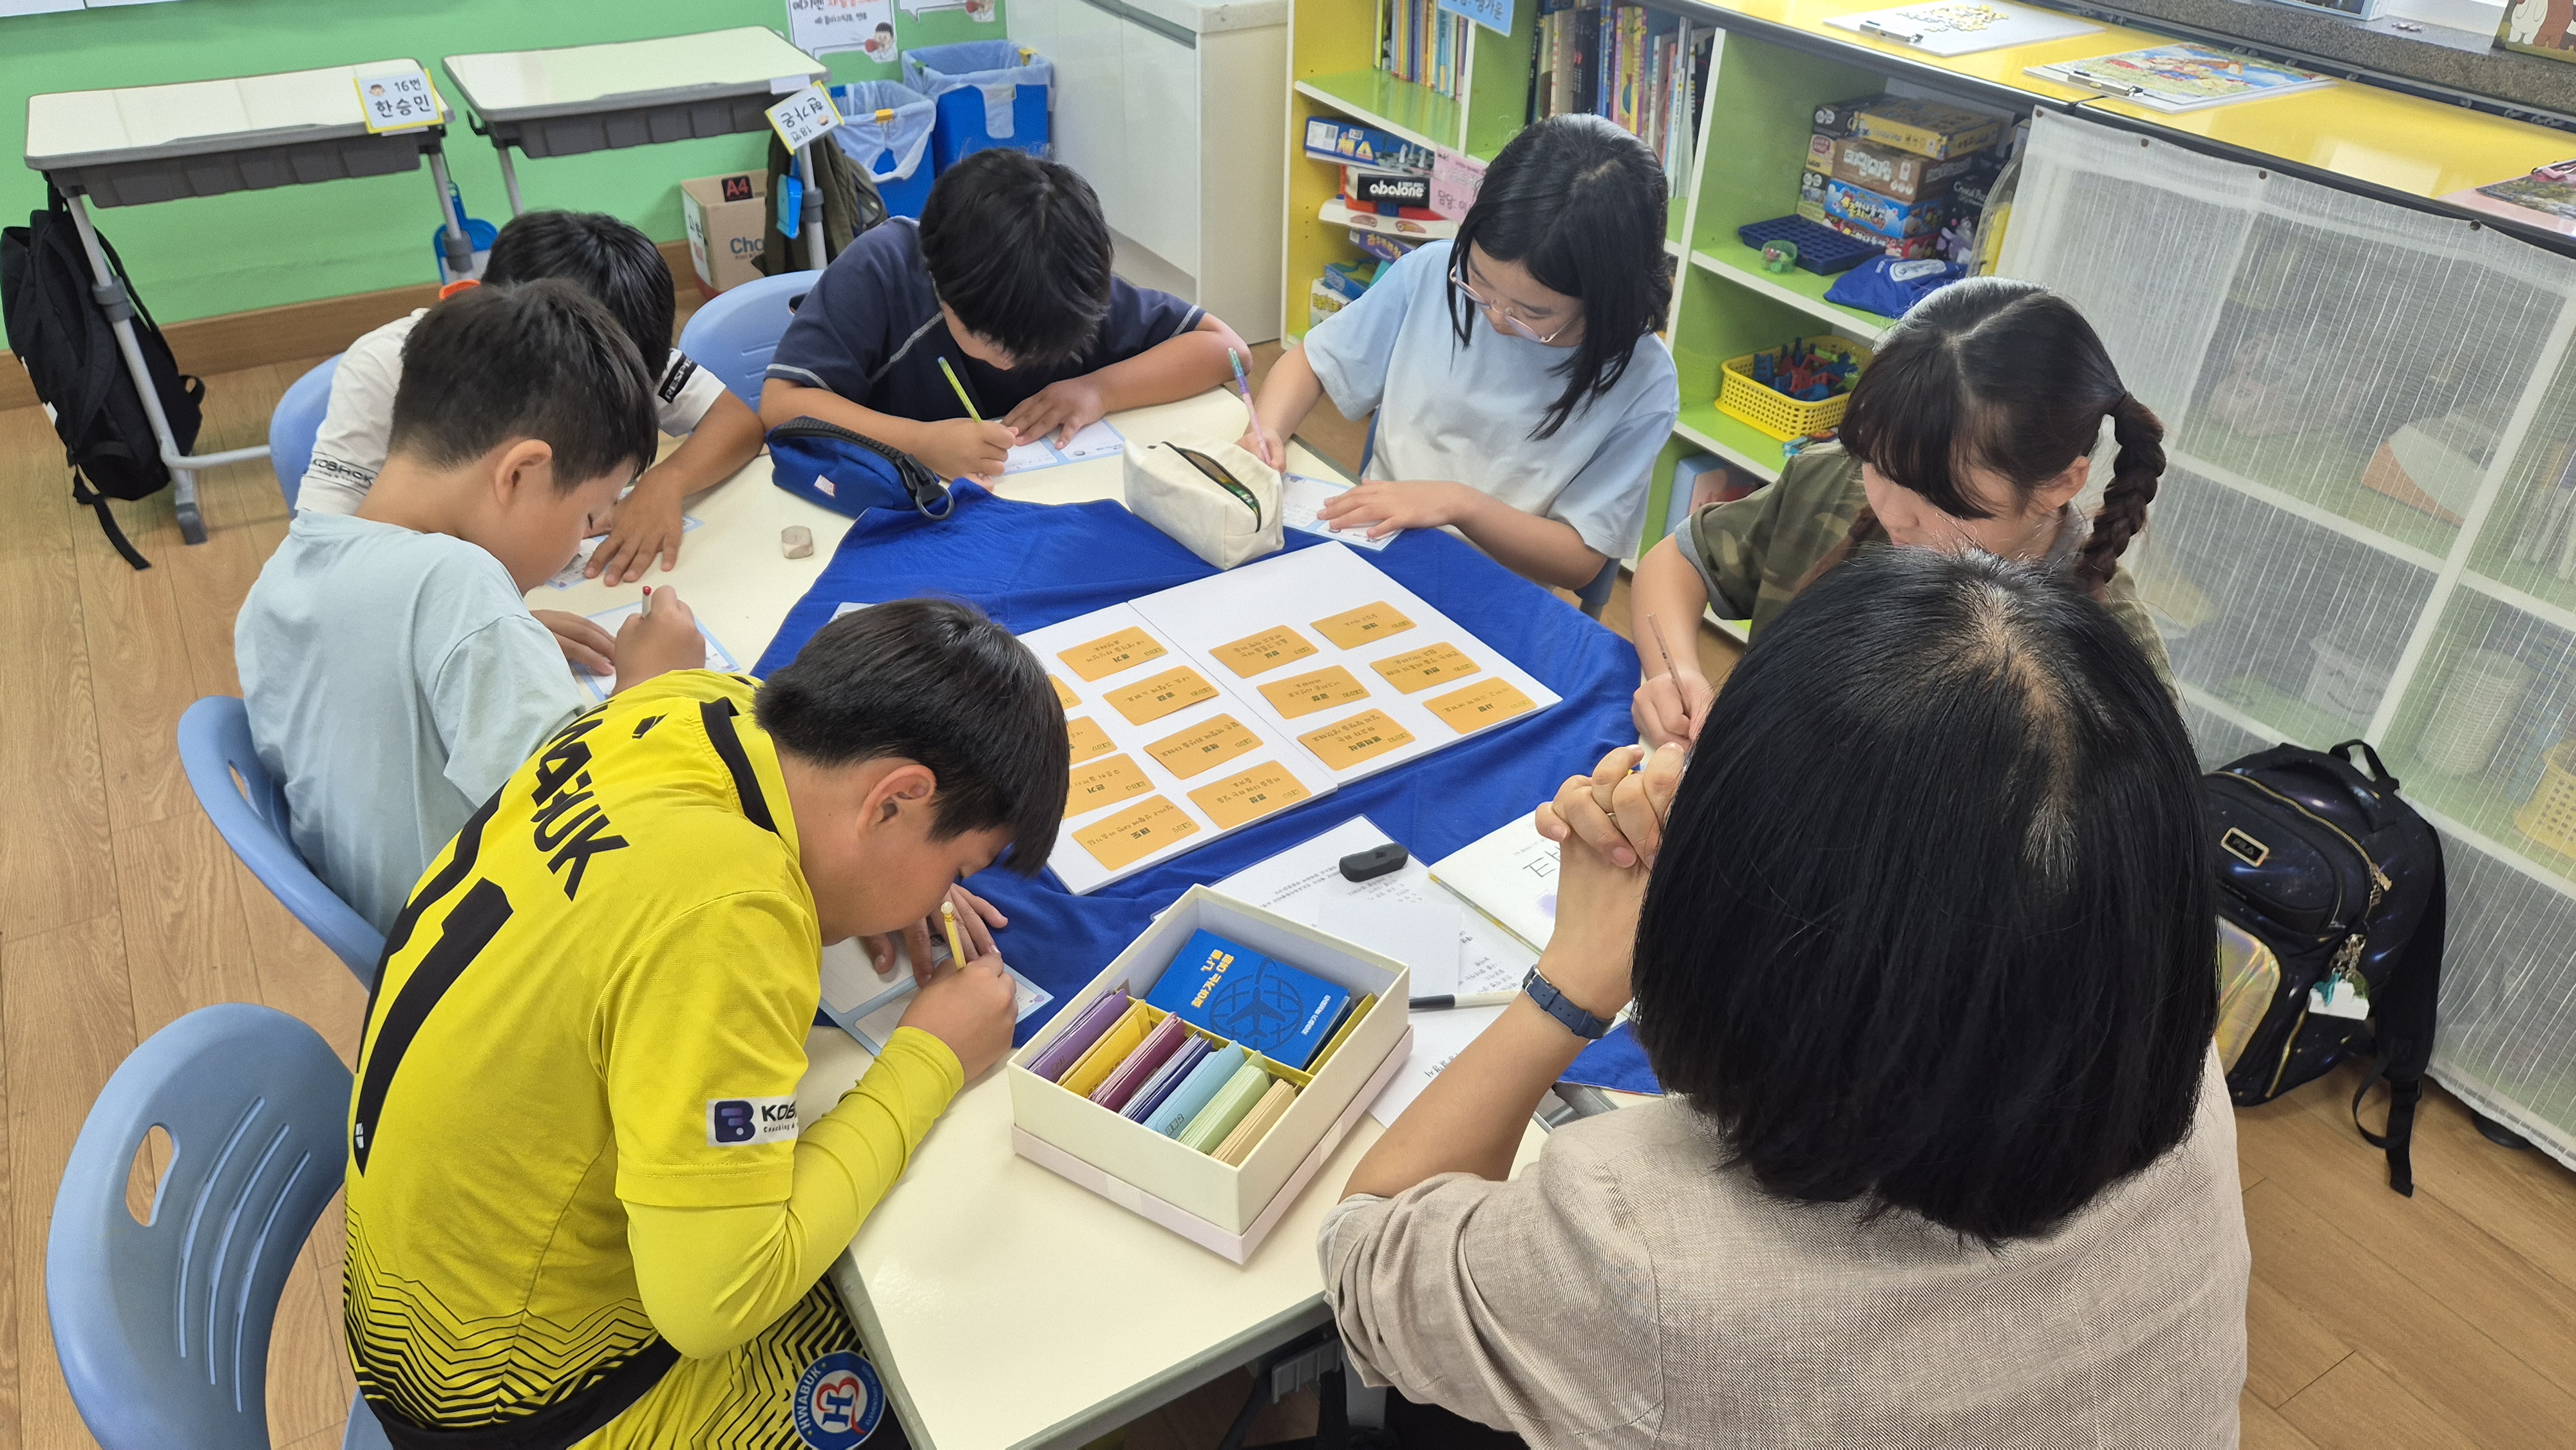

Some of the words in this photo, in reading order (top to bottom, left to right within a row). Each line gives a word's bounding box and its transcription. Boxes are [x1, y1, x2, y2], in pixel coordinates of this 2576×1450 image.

[394, 79, 420, 91] 16번
[375, 95, 430, 117] 한승민
[781, 97, 822, 127] 현가온
[791, 126, 811, 142] 18번
[726, 178, 750, 196] A4
[1150, 682, 1172, 693] 그렇게
[1157, 692, 1175, 701] 공감
[1477, 703, 1493, 711] 사랑
[1204, 729, 1224, 739] 역할에
[1353, 726, 1374, 736] 하고자
[1182, 737, 1203, 748] 최선을
[1202, 743, 1218, 753] 책임
[1348, 736, 1381, 751] 목적의식
[1098, 769, 1120, 778] 꾸준히
[1074, 776, 1096, 786] 끝까지
[1260, 777, 1280, 786] 마음을
[1086, 784, 1104, 793] 끈기
[1217, 795, 1231, 803] 일을
[1249, 793, 1266, 803] 열정
[1153, 804, 1173, 815] 일이나
[1132, 814, 1151, 825] 상황에
[1087, 831, 1115, 845] 마음가짐
[1131, 827, 1150, 838] 태도
[1191, 969, 1220, 1007] 찾아가는
[1216, 954, 1233, 972] 여행
[797, 1366, 821, 1430] HWABUK
